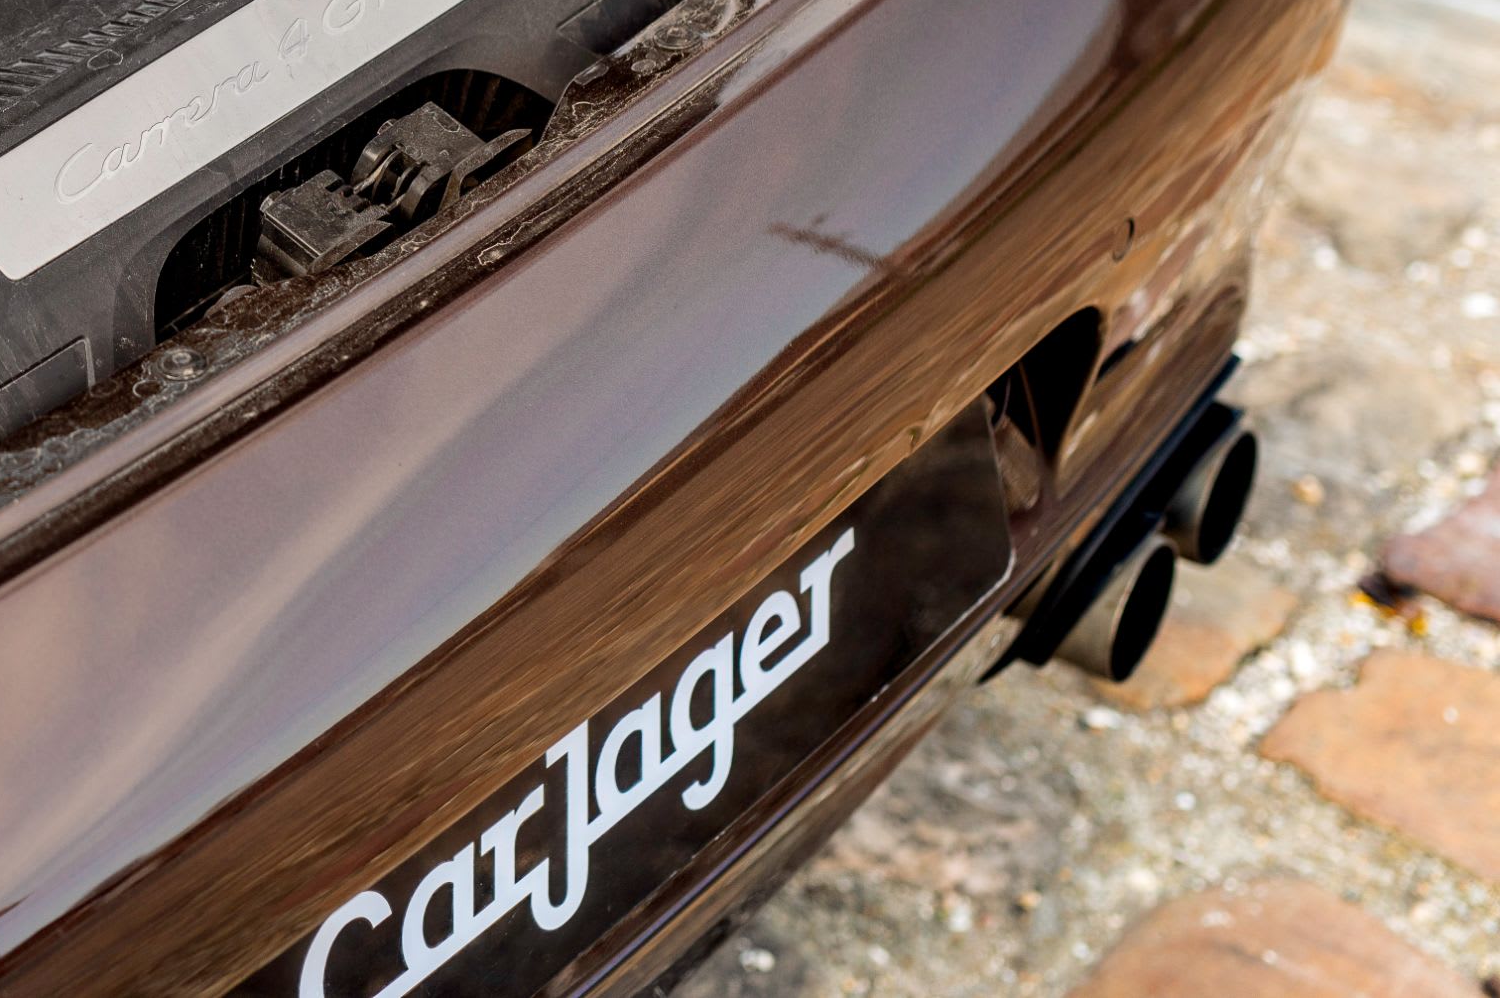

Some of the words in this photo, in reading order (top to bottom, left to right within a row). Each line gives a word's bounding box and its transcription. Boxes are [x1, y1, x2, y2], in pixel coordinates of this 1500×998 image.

[54, 60, 270, 204] Carrera
[277, 17, 312, 62] 4
[298, 527, 855, 998] CarJager
